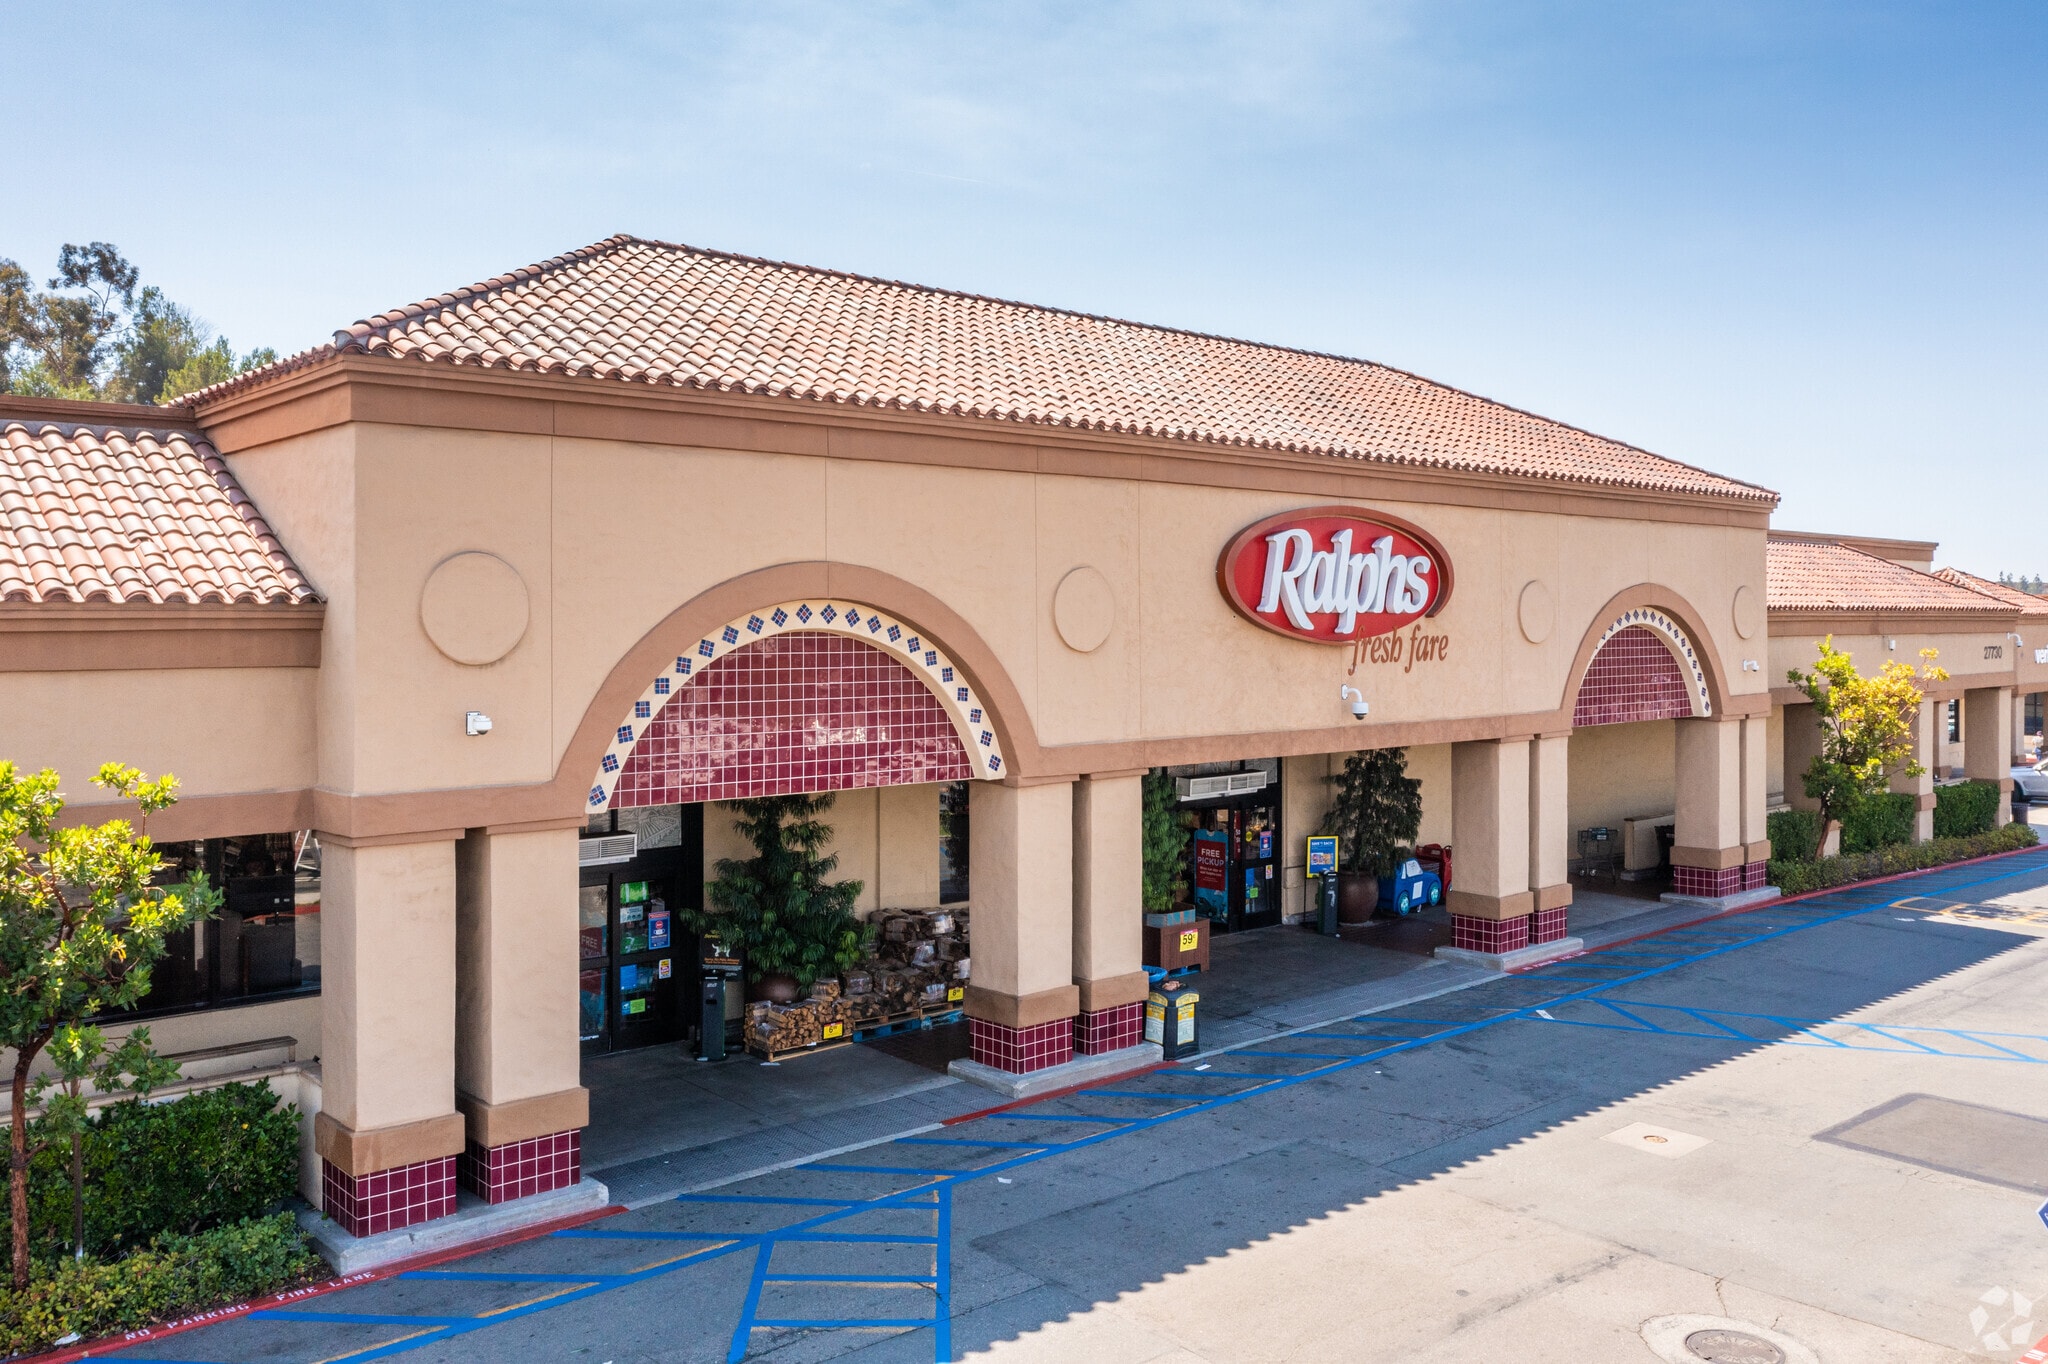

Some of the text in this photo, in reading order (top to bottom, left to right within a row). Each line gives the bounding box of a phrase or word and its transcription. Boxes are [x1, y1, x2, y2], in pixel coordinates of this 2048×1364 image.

[1256, 528, 1431, 635] Ralphs
[1348, 623, 1450, 677] fresh fare
[1984, 646, 2003, 660] 27730
[1201, 848, 1221, 858] FREE
[1197, 856, 1225, 867] PICKUP
[581, 935, 598, 949] FREE
[124, 1271, 377, 1341] NO PARKING FIRE LANE
